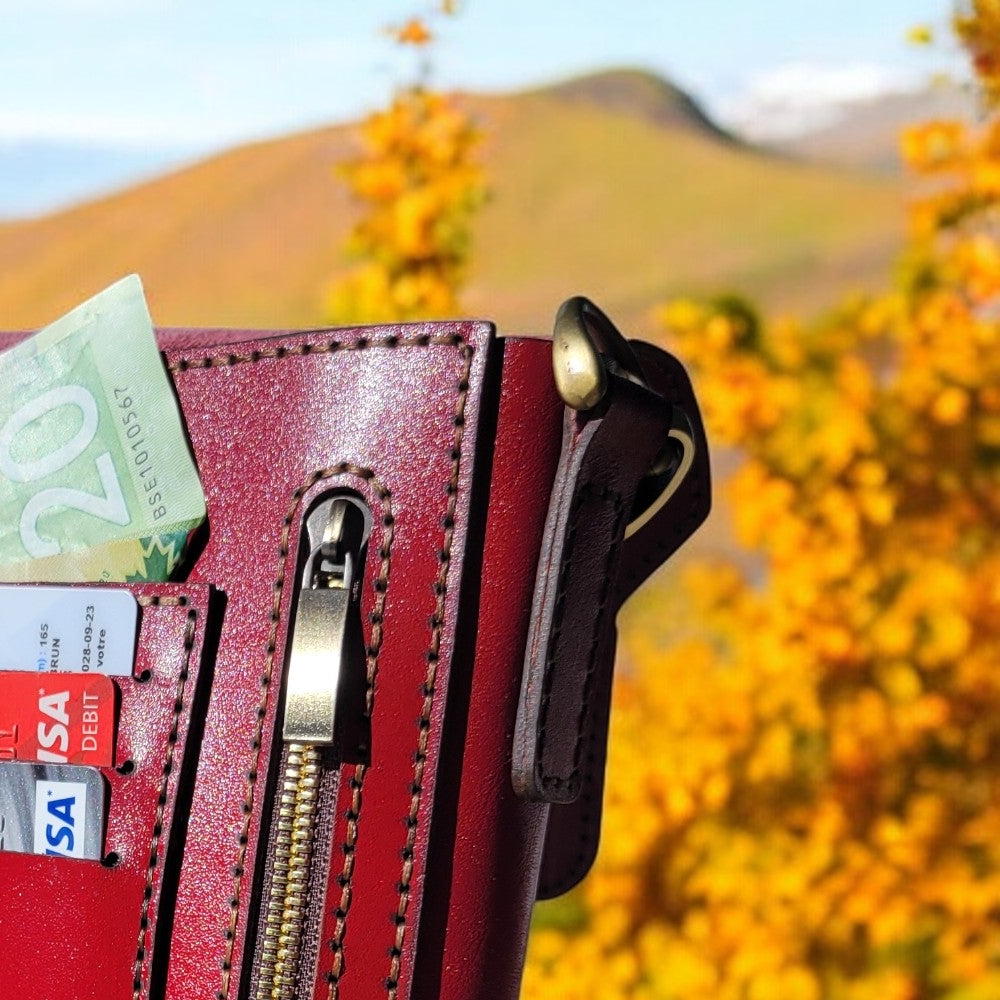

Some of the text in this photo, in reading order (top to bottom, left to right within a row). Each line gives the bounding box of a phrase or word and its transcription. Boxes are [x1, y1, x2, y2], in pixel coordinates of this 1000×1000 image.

[114, 387, 167, 521] BSE1010567
[40, 623, 49, 648] 165
[97, 629, 106, 668] votre
[81, 691, 99, 751] DEBIT
